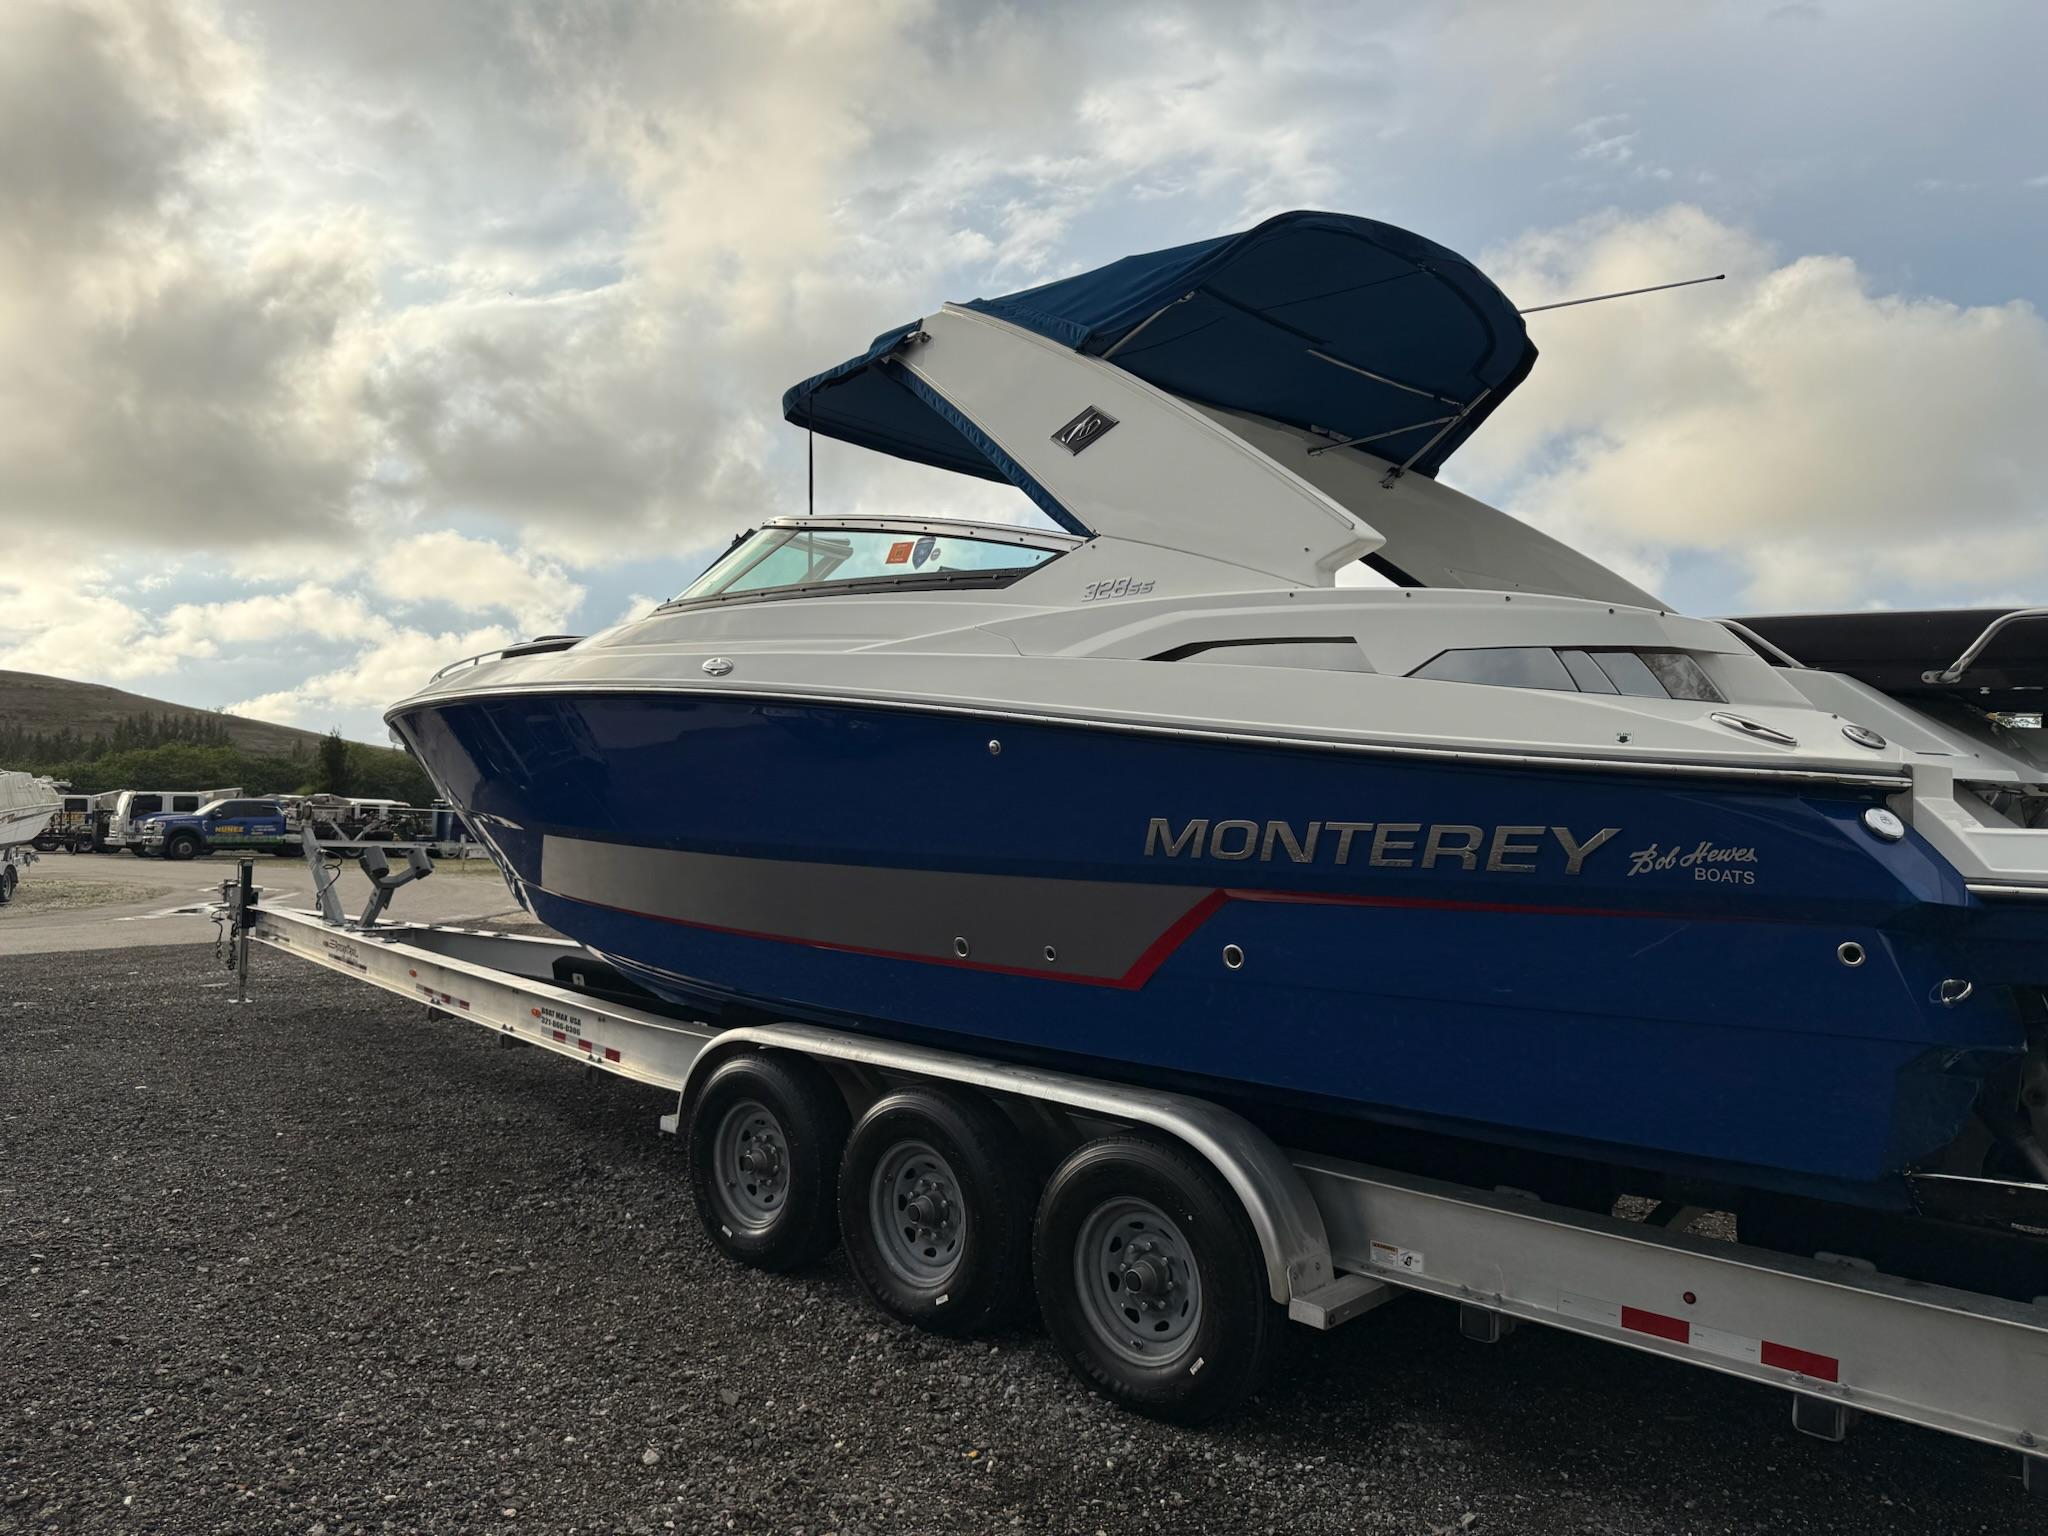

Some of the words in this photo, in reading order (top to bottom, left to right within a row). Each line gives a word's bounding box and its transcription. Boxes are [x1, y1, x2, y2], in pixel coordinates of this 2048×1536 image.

[1143, 817, 1623, 876] MONTEREY
[1627, 843, 1680, 876] Bob
[1680, 841, 1758, 867] Hewes
[1694, 867, 1755, 885] BOATS
